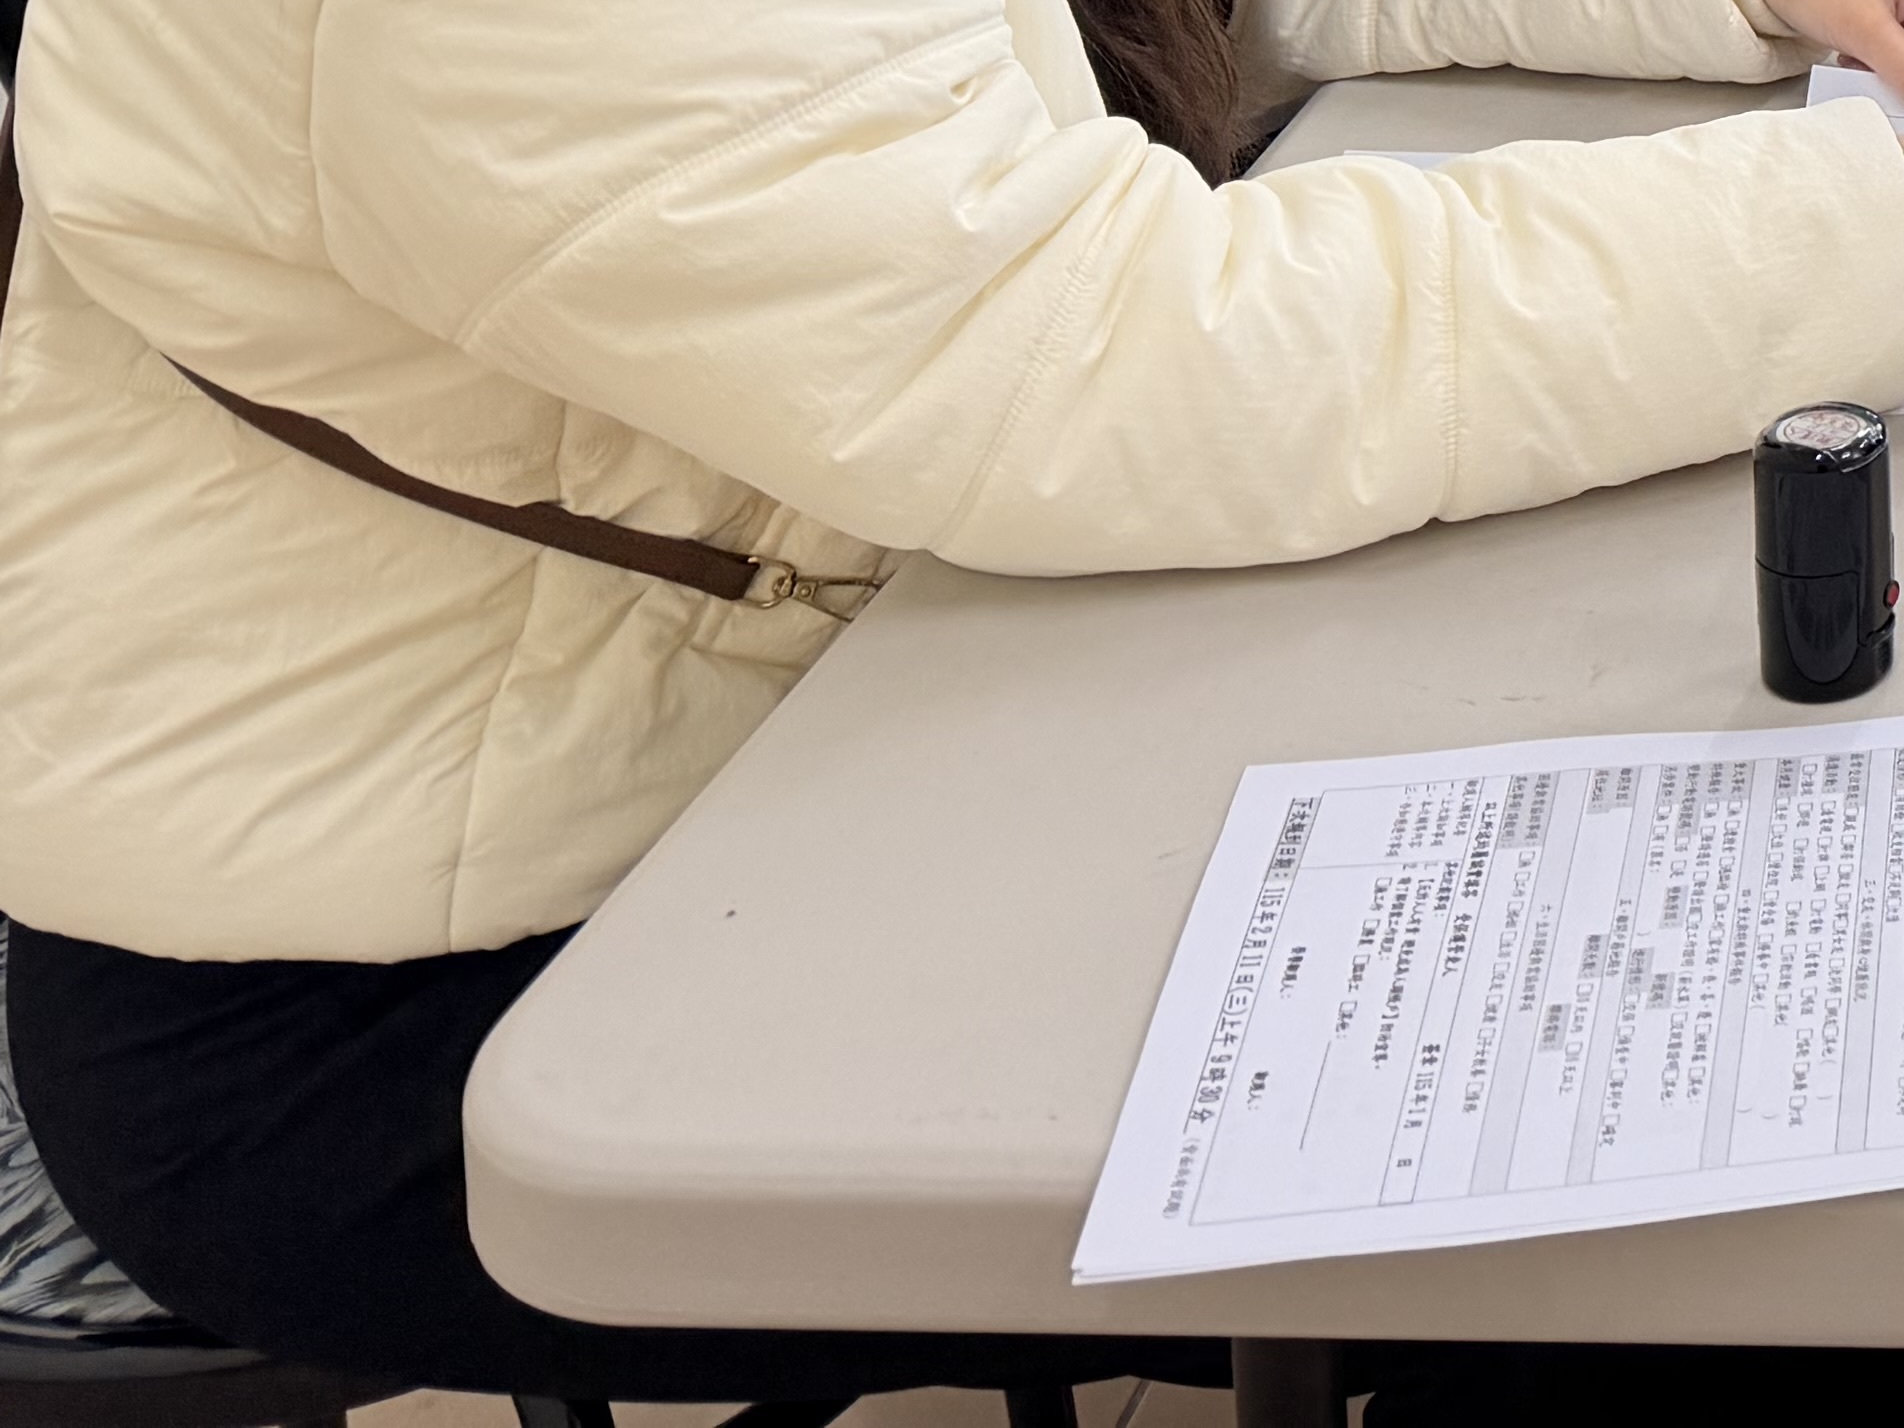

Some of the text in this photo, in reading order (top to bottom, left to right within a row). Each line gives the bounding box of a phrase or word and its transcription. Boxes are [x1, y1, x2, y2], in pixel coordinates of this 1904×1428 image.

[1269, 796, 1315, 878] 下次報到日期：
